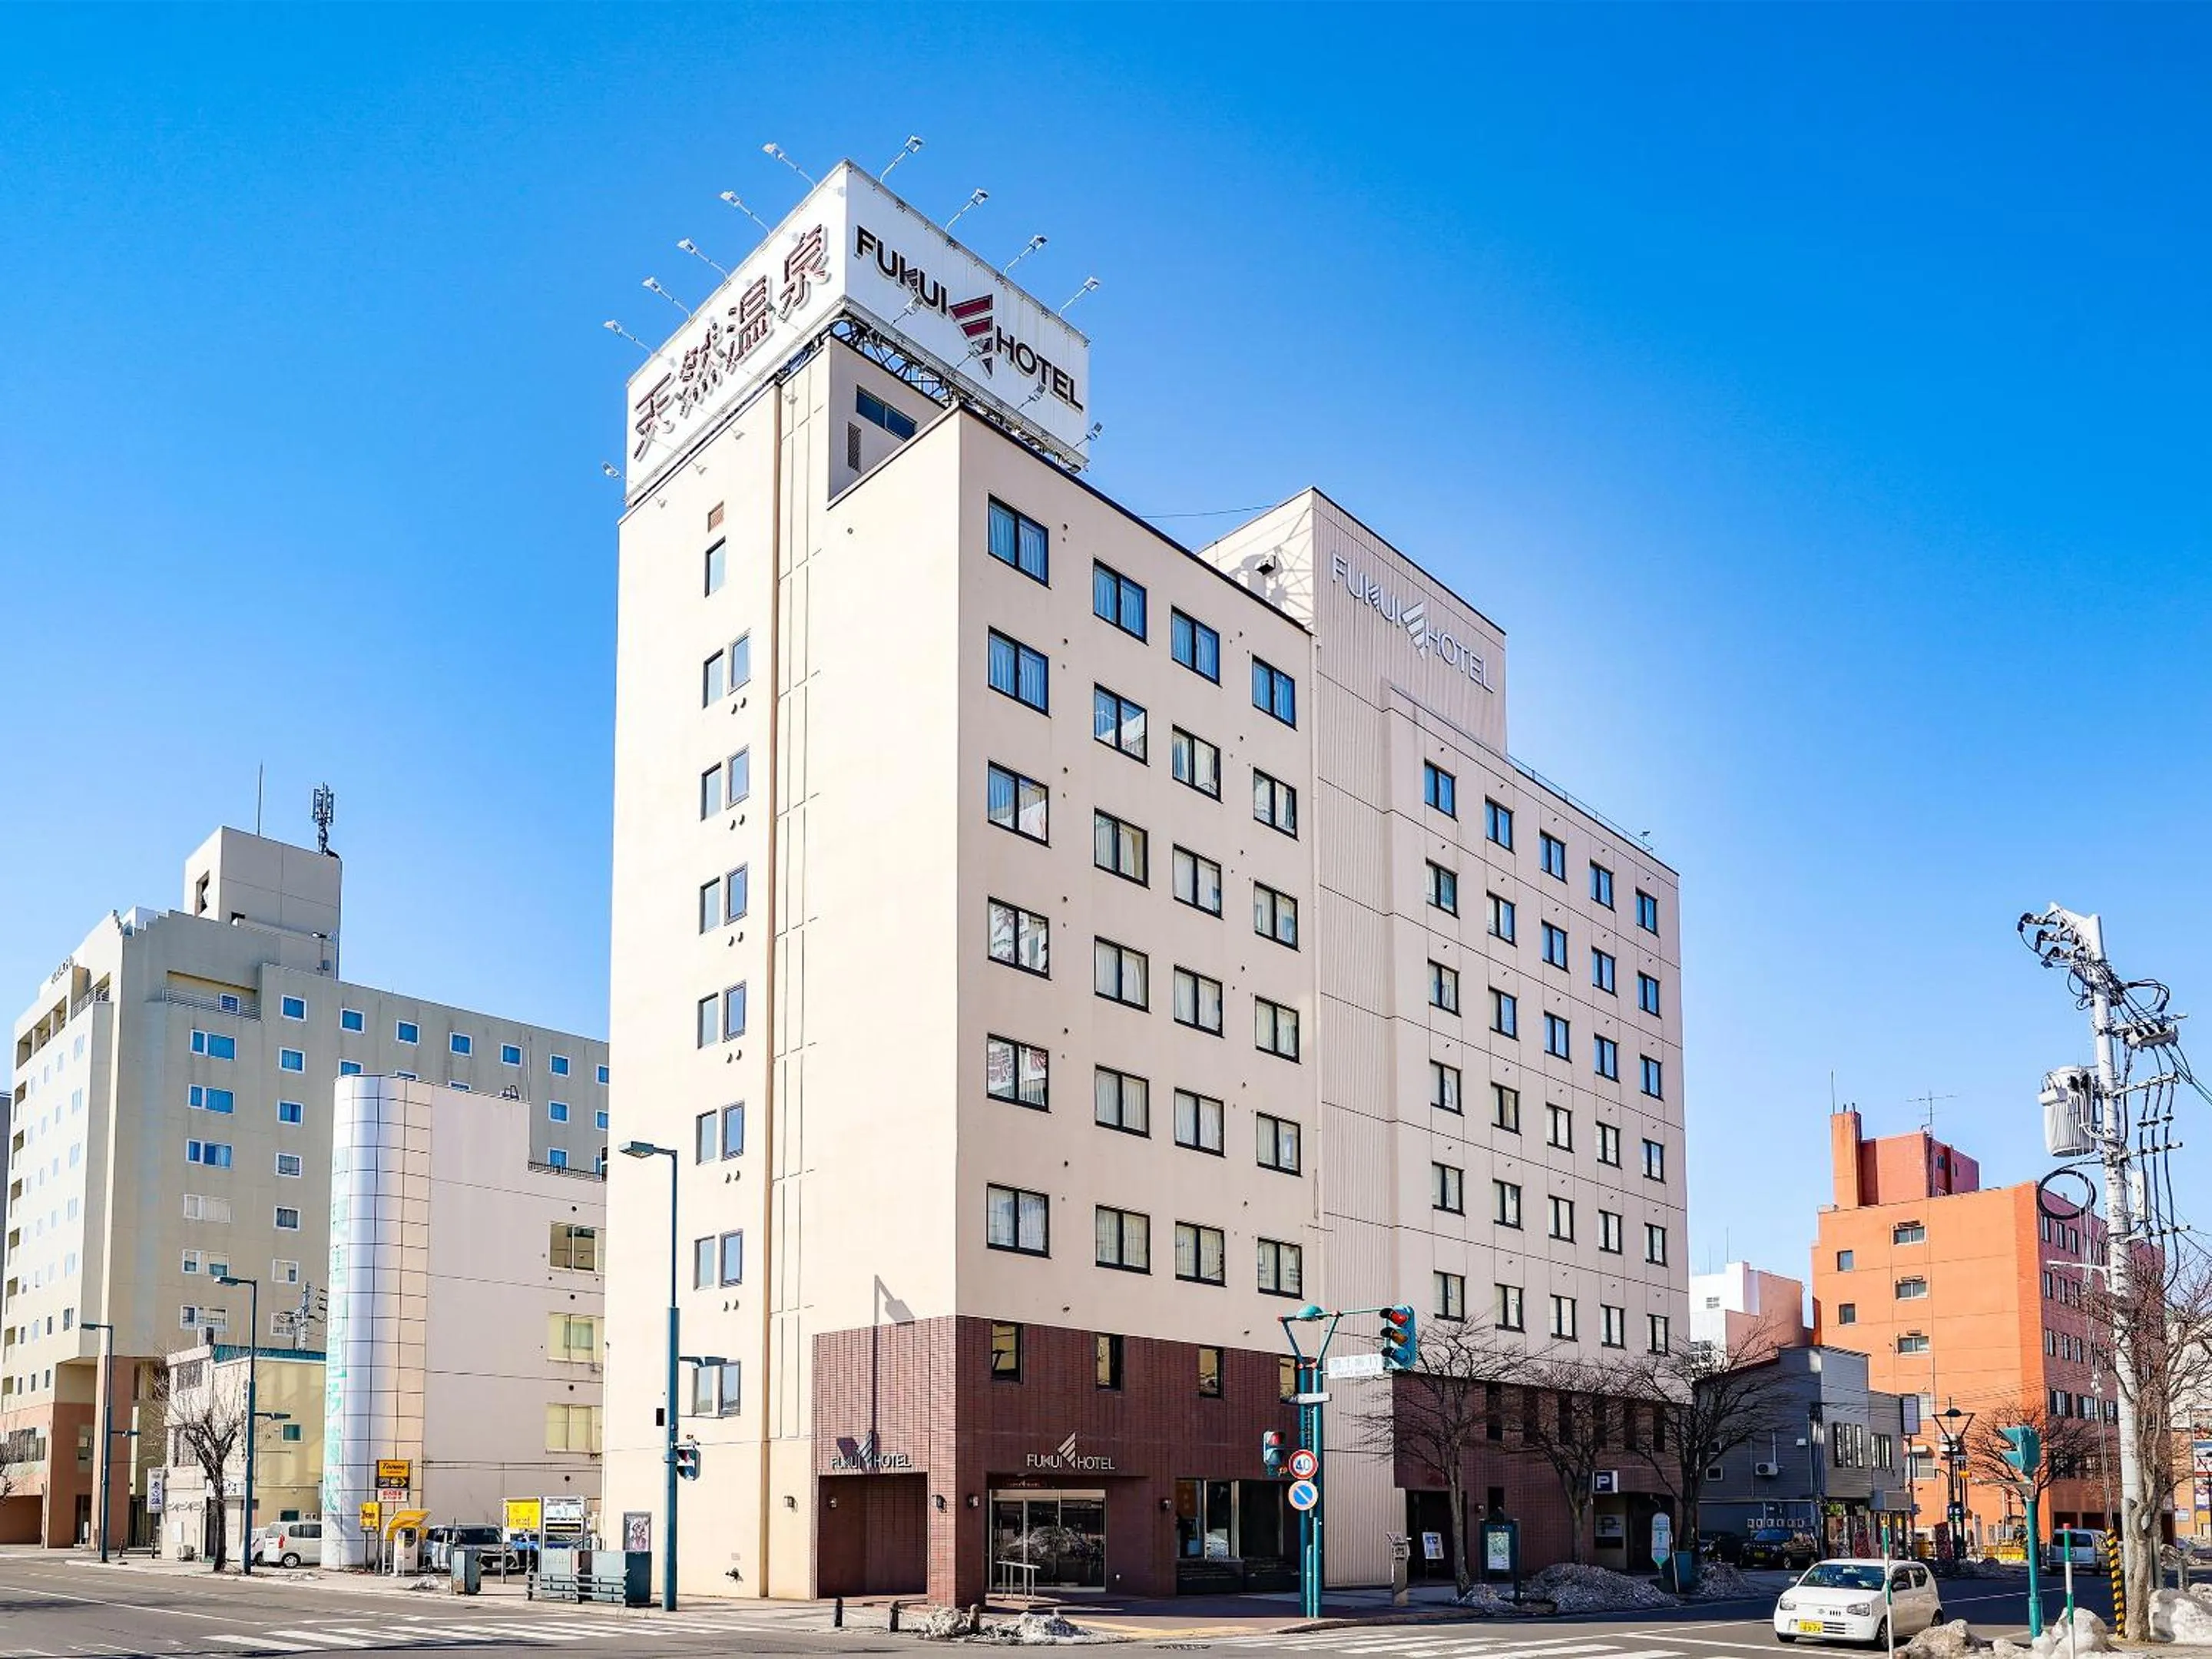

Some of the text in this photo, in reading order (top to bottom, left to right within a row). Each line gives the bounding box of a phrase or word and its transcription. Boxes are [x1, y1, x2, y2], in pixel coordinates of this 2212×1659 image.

[854, 224, 1084, 411] FUKUI HOTEL
[633, 223, 830, 461] 天然温泉
[1332, 552, 1494, 694] FUKUI HOTEL
[874, 1452, 912, 1469] HOTEL
[1026, 1454, 1115, 1469] FUKUI HOTEL
[1295, 1459, 1310, 1471] 40
[1597, 1475, 1610, 1488] P
